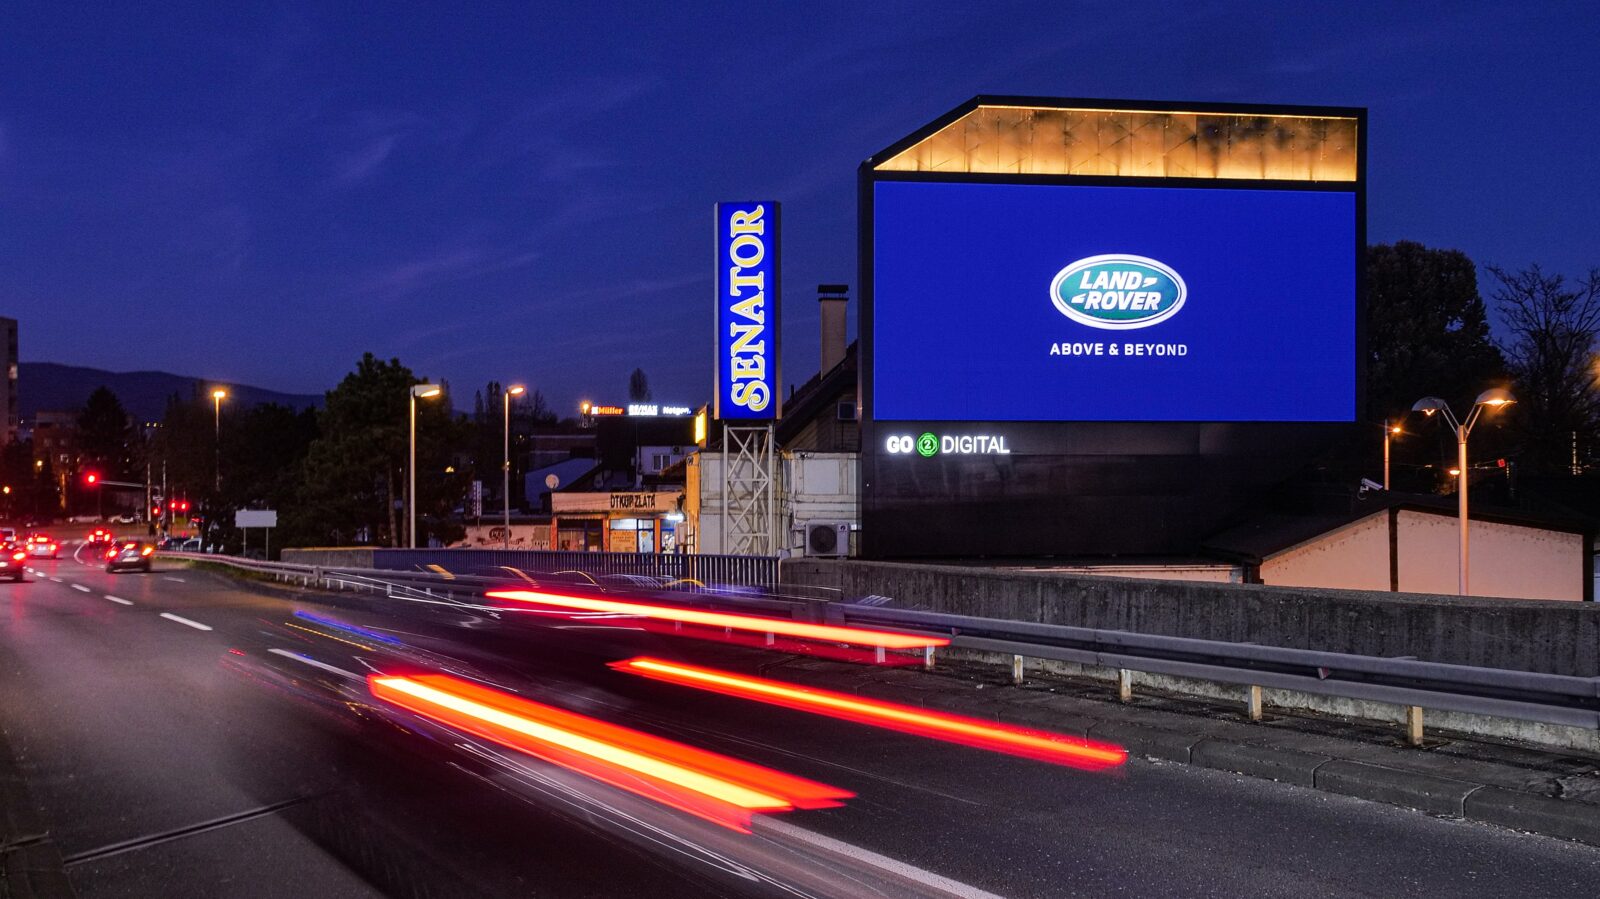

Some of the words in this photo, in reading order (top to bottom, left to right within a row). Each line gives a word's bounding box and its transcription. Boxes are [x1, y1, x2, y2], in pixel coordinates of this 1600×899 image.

[1079, 270, 1143, 290] LAND
[729, 204, 770, 412] SENATOR
[1083, 290, 1162, 311] ROVER
[1050, 342, 1104, 356] ABOVE
[1108, 342, 1119, 356] &
[1124, 343, 1188, 356] BEYOND
[886, 435, 914, 454] GO
[941, 435, 1010, 454] DIGITAL
[610, 493, 633, 508] OTKUP
[634, 493, 656, 508] ZLATA
